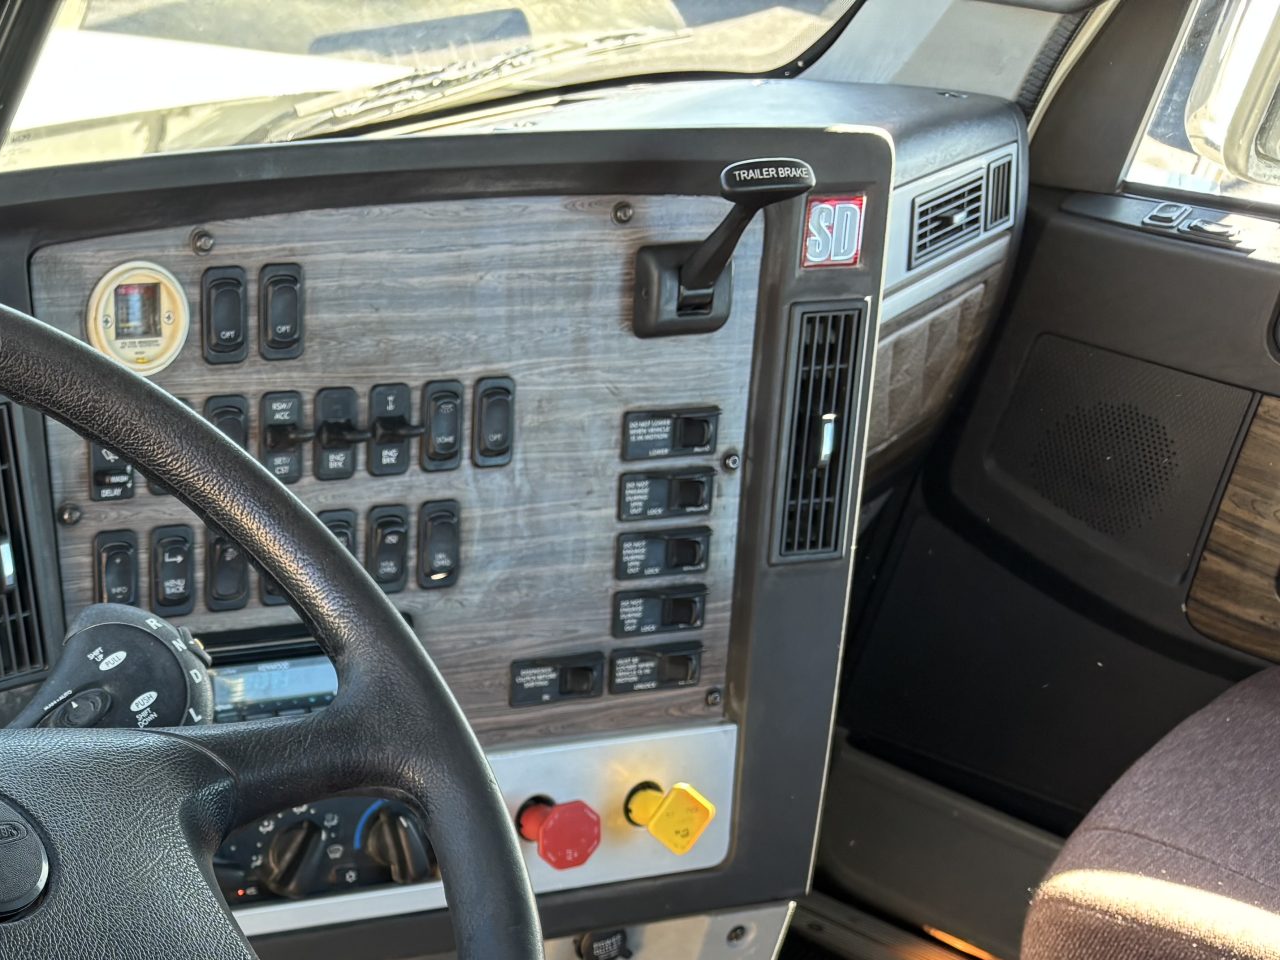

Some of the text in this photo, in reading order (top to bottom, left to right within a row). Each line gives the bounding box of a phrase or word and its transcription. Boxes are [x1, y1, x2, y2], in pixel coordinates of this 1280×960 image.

[733, 167, 809, 181] TRAILER BRAKE
[806, 203, 861, 262] SD
[220, 330, 235, 339] OPT
[276, 325, 291, 334] OPT
[274, 411, 290, 420] ACC
[101, 488, 124, 497] DELAY
[145, 618, 163, 630] R
[172, 638, 187, 652] N
[87, 647, 104, 661] SHIFT
[95, 654, 104, 662] UP
[105, 655, 122, 667] PULL
[189, 669, 202, 683] D
[136, 695, 153, 708] PUSH
[136, 708, 151, 721] SHIFT
[137, 713, 158, 728] DOWN
[189, 708, 202, 723] L
